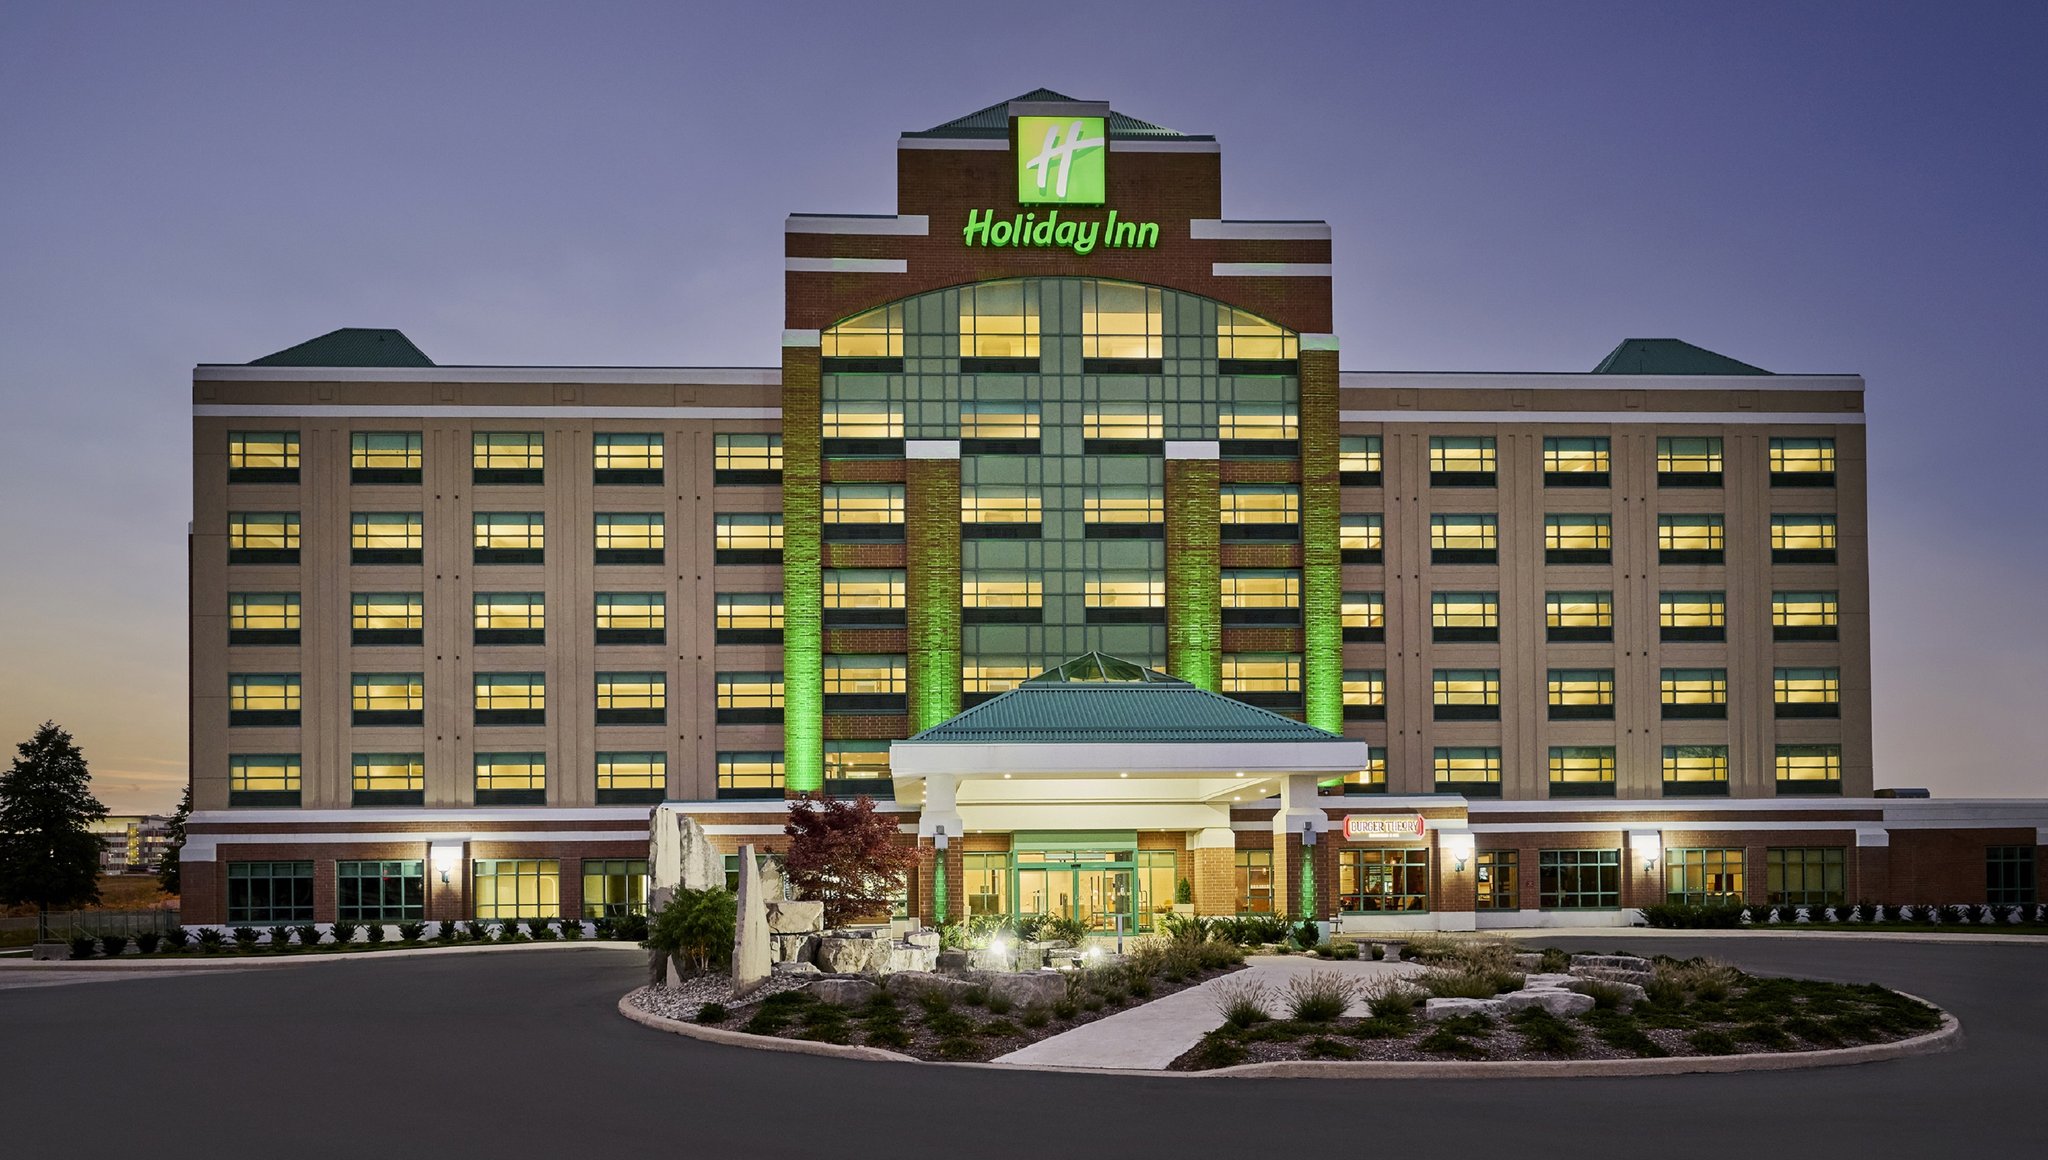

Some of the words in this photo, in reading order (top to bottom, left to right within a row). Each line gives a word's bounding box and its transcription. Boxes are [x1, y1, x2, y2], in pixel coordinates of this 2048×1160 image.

[1026, 120, 1104, 198] H
[963, 208, 1100, 255] Holiday
[1104, 210, 1159, 248] Inn
[1351, 821, 1384, 832] BURGER
[1385, 821, 1418, 832] THEORY
